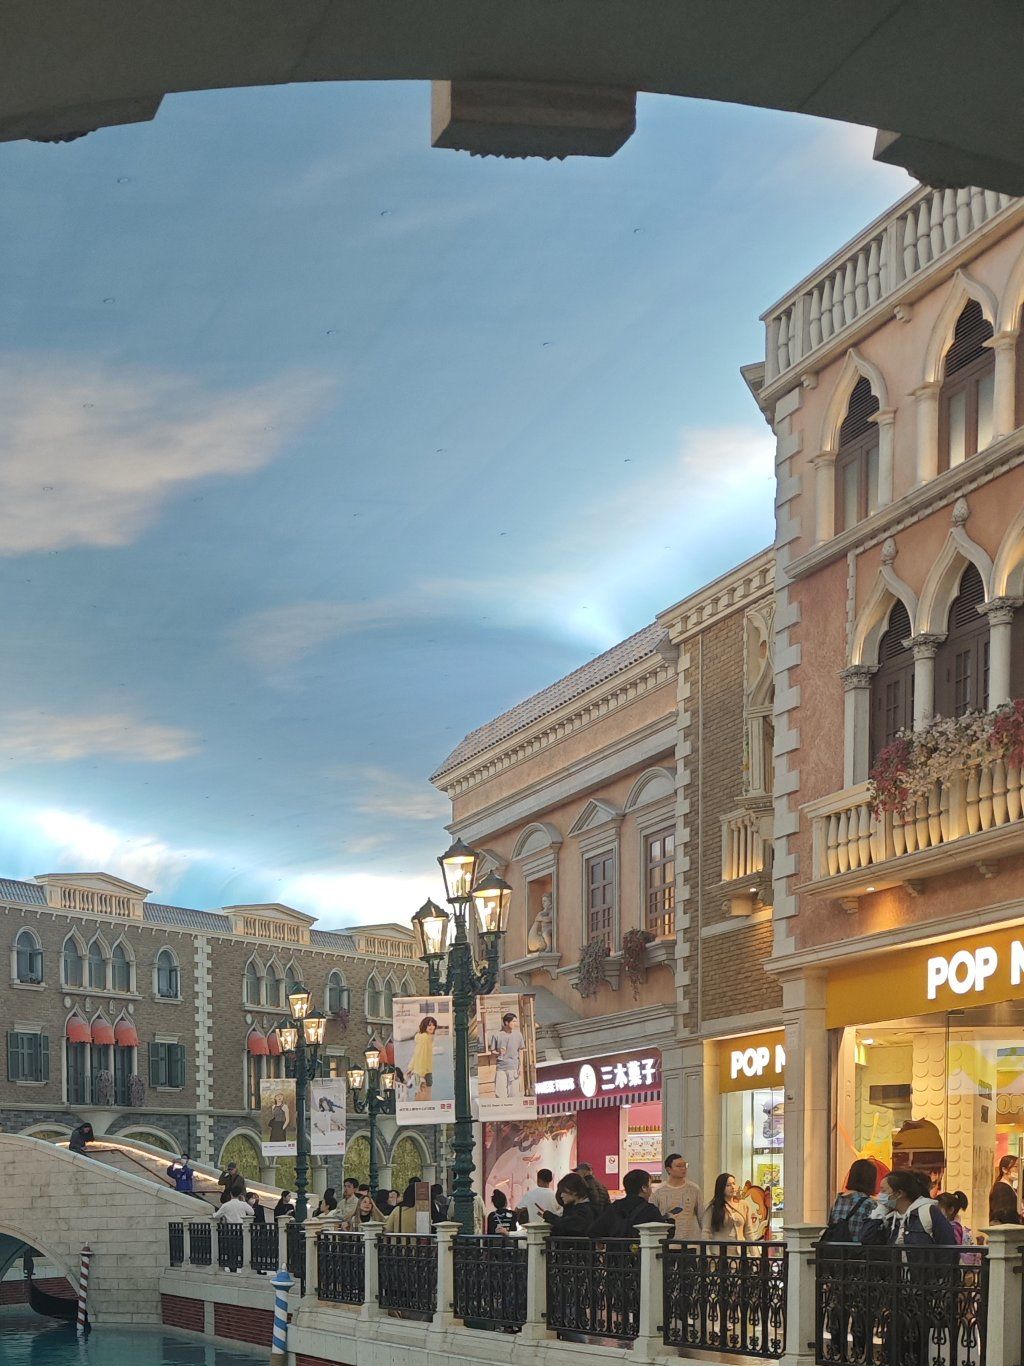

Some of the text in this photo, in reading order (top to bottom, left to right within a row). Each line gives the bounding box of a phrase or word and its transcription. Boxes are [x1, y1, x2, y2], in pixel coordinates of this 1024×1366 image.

[927, 946, 998, 1000] POP
[600, 1059, 656, 1090] 三木菓子
[731, 1046, 770, 1079] POP
